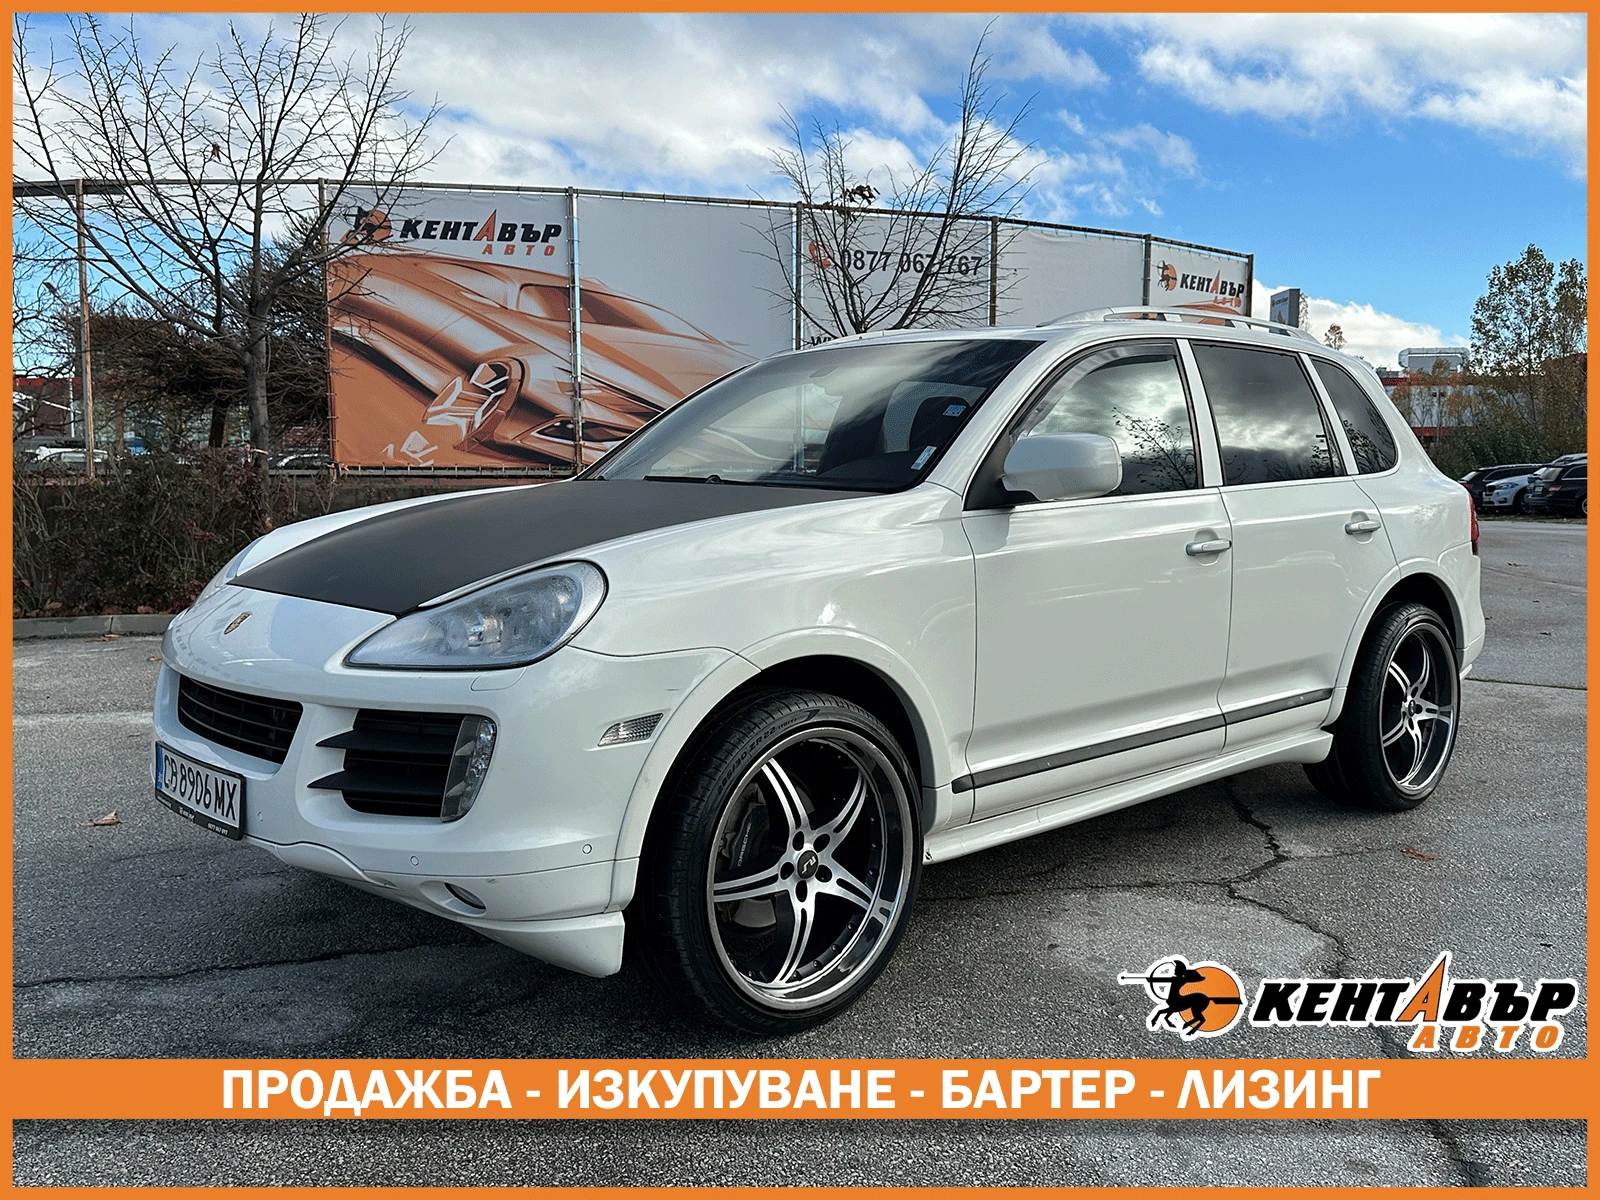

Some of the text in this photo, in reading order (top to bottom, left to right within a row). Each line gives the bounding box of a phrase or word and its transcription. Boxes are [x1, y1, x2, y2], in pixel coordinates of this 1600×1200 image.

[400, 209, 562, 243] КЕНТАВЪР
[482, 243, 555, 256] АВТО
[842, 249, 891, 271] 0877
[1180, 270, 1245, 297] КЕНТАВЪР
